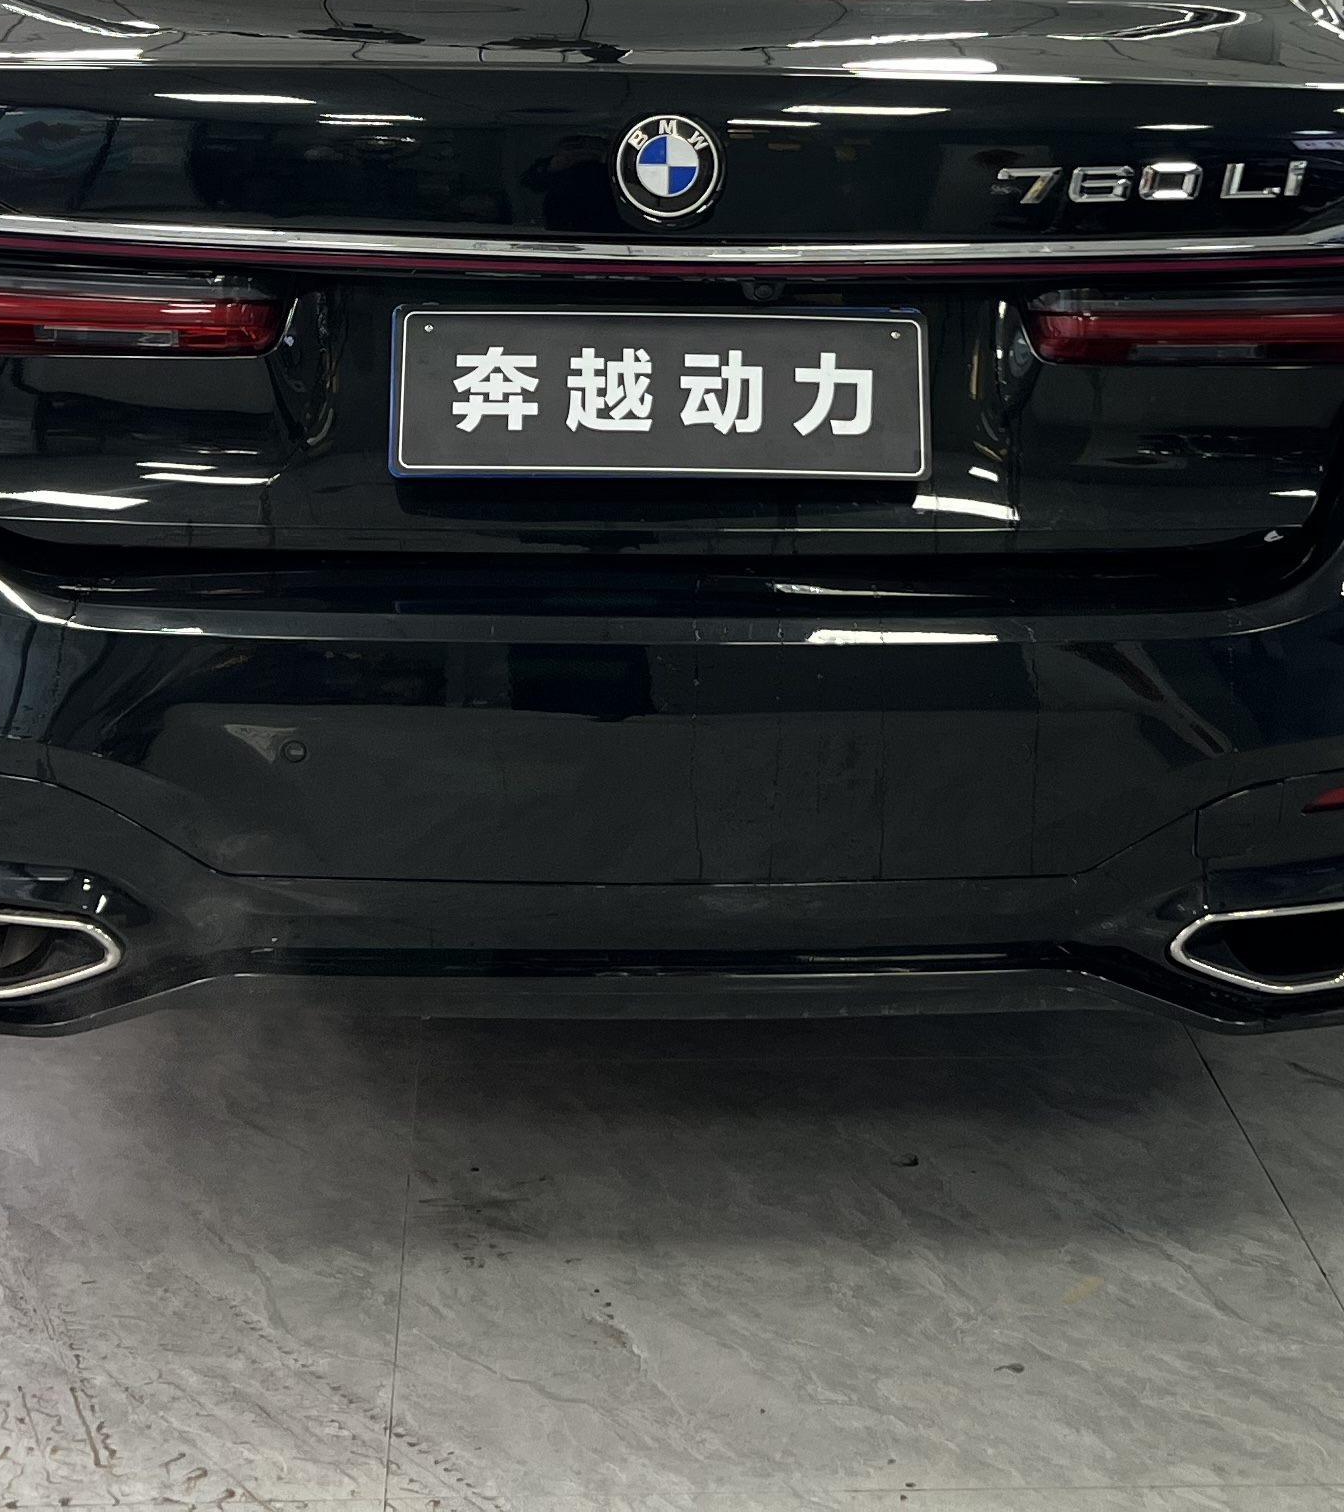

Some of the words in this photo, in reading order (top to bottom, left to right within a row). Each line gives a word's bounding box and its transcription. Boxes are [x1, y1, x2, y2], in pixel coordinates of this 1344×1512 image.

[627, 119, 709, 151] BMW
[452, 346, 874, 437] 奔越动力
